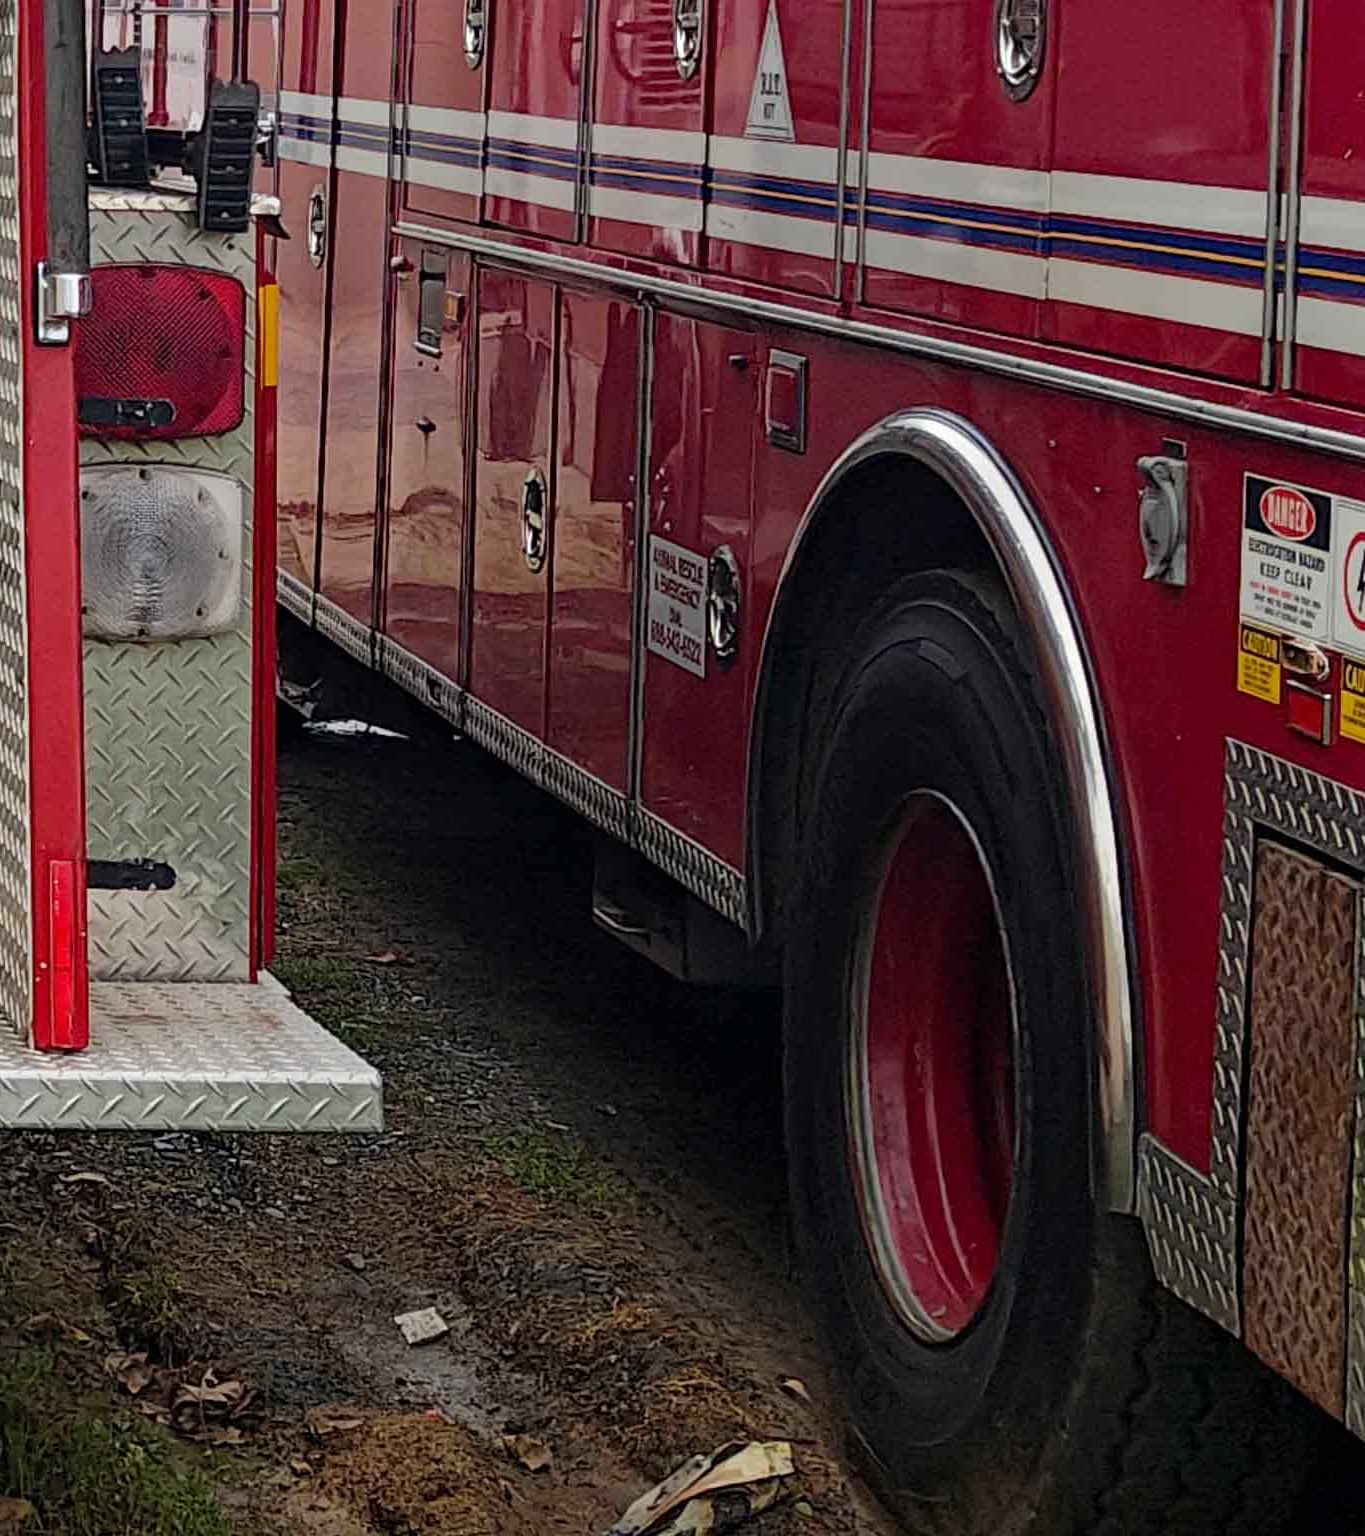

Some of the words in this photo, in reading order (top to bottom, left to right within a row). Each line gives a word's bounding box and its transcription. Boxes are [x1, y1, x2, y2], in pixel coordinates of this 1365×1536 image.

[1268, 493, 1308, 533] DANGER
[1260, 562, 1281, 579] KEEP
[1284, 569, 1313, 591] CLEAR
